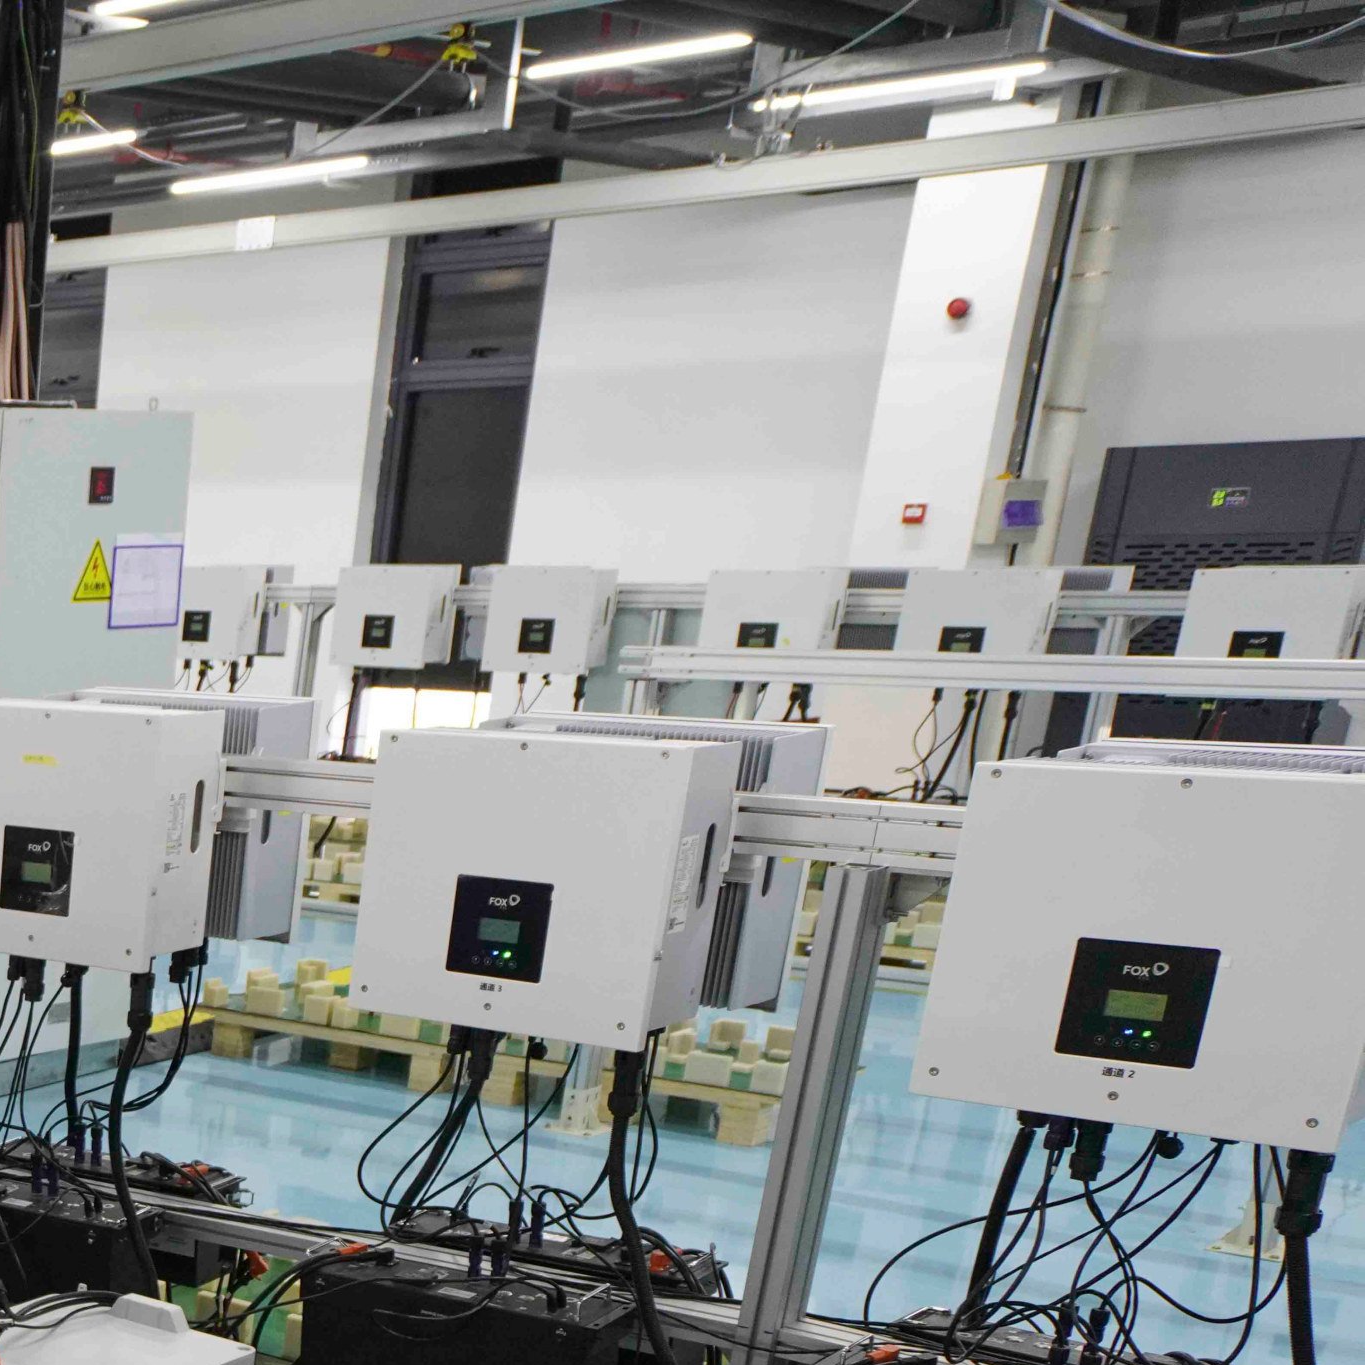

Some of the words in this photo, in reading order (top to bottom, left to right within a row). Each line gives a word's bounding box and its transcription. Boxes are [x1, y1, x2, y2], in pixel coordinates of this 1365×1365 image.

[28, 843, 42, 852] FOX
[488, 896, 508, 907] FOX
[1122, 964, 1151, 977] FOX
[1101, 1066, 1125, 1079] 通道
[1128, 1070, 1136, 1079] 2
